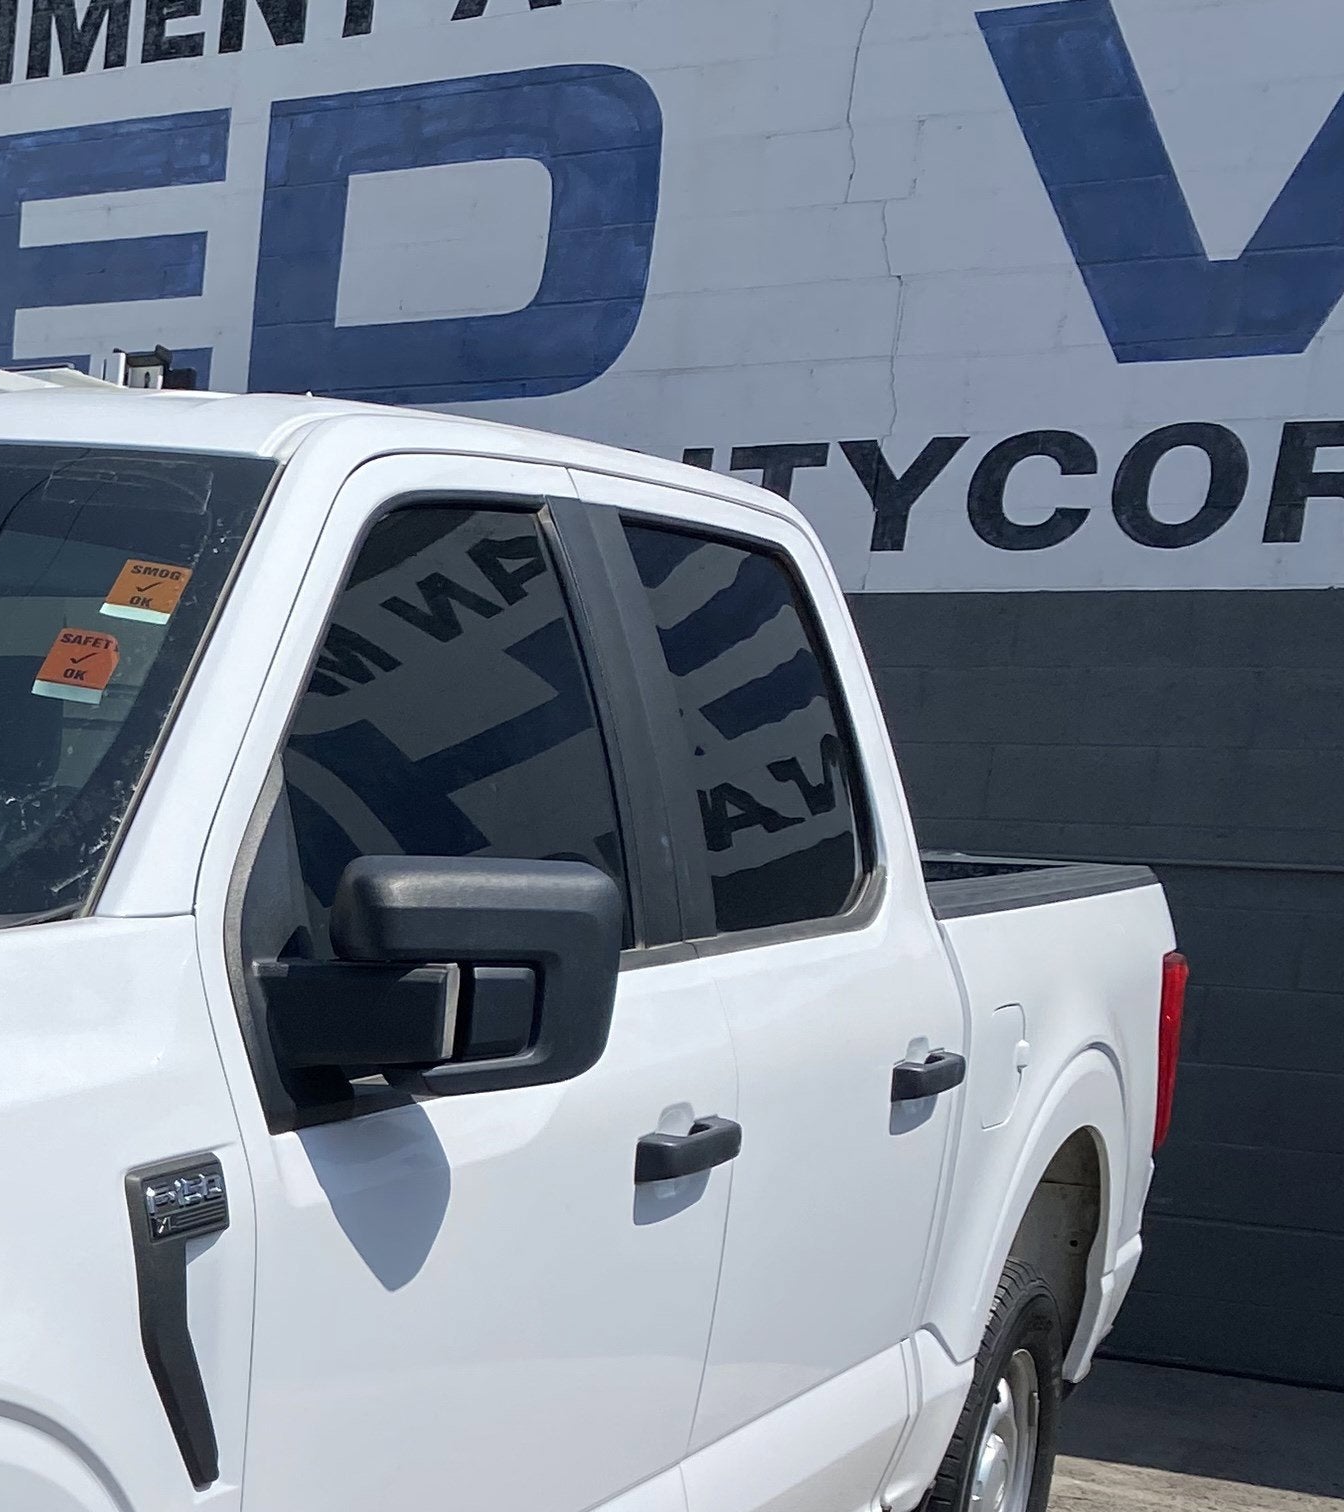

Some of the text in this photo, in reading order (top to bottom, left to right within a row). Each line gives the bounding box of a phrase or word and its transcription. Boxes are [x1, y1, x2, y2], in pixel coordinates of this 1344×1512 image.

[130, 565, 183, 581] SMOG
[129, 595, 153, 608] OK
[63, 667, 87, 681] OK
